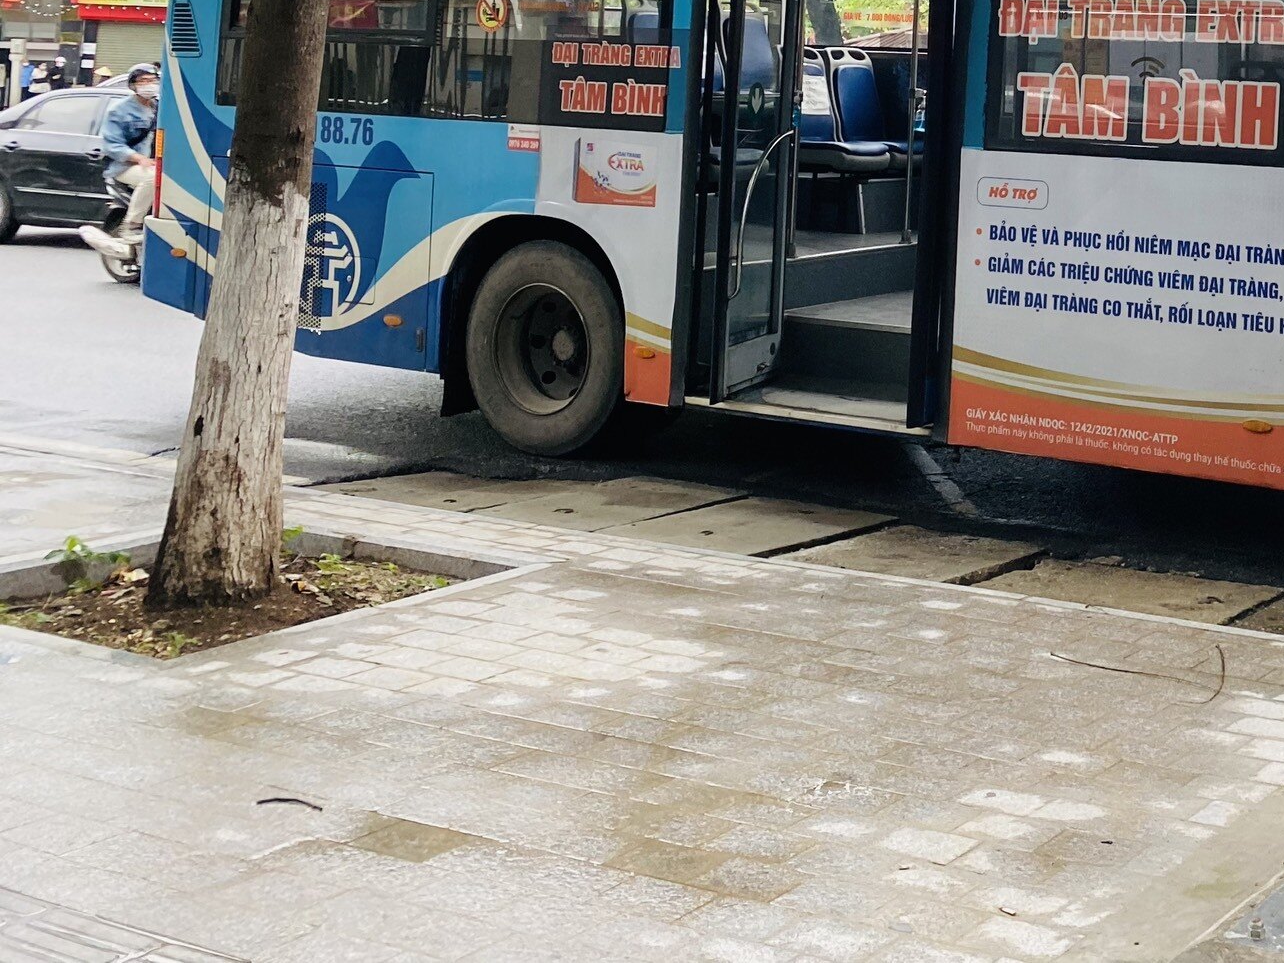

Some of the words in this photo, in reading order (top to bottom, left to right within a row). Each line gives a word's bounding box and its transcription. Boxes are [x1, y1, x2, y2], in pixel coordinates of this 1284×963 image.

[551, 41, 580, 68] ĐẠI
[581, 40, 632, 67] TRÀNG
[633, 44, 682, 69] EXTRA
[559, 75, 608, 114] TÂM
[610, 78, 668, 117] BÌNH
[1016, 62, 1131, 142] TÂM
[1141, 68, 1281, 151] BÌNH
[315, 115, 375, 147] 88.76
[988, 182, 1010, 199] HỖ
[1011, 187, 1039, 204] TRỢ
[988, 220, 1018, 242] BẢO
[1020, 224, 1038, 247] VỆ
[1041, 226, 1060, 246] VÀ
[1063, 230, 1102, 252] PHỤC
[1106, 229, 1130, 252] HỒI
[1134, 234, 1173, 256] NIÊM
[1176, 239, 1211, 262] MẠC
[1214, 243, 1241, 265] ĐẠI
[987, 252, 1024, 275] GIẢM
[1027, 257, 1056, 278] CÁC
[1060, 261, 1100, 285] TRIỆU
[1104, 265, 1154, 287] CHỨNG
[1157, 269, 1195, 291] VIÊM
[1198, 274, 1225, 297] ĐẠI
[1228, 276, 1284, 303] TRÀNG,
[986, 286, 1021, 307] VIÊM
[1024, 291, 1048, 313] ĐẠI
[1051, 292, 1099, 315] TRÀNG
[1102, 299, 1122, 317] CO
[1126, 297, 1164, 324] THẮT,
[1168, 301, 1193, 325] RỐI
[1197, 308, 1238, 332] LOẠN
[1241, 311, 1275, 334] TIÊU
[965, 407, 987, 420] GIẤY
[988, 410, 1008, 423] XÁC
[1009, 413, 1038, 426] NHẬN
[965, 421, 987, 433] Thực
[987, 424, 1012, 436] phẩm
[1028, 429, 1055, 444] không
[1075, 435, 1084, 446] là
[1112, 441, 1139, 456] không
[1140, 444, 1151, 455] có
[1153, 446, 1168, 458] tác
[1169, 450, 1192, 464] dụng
[1193, 452, 1213, 466] thay
[1230, 457, 1257, 471] thuốc
